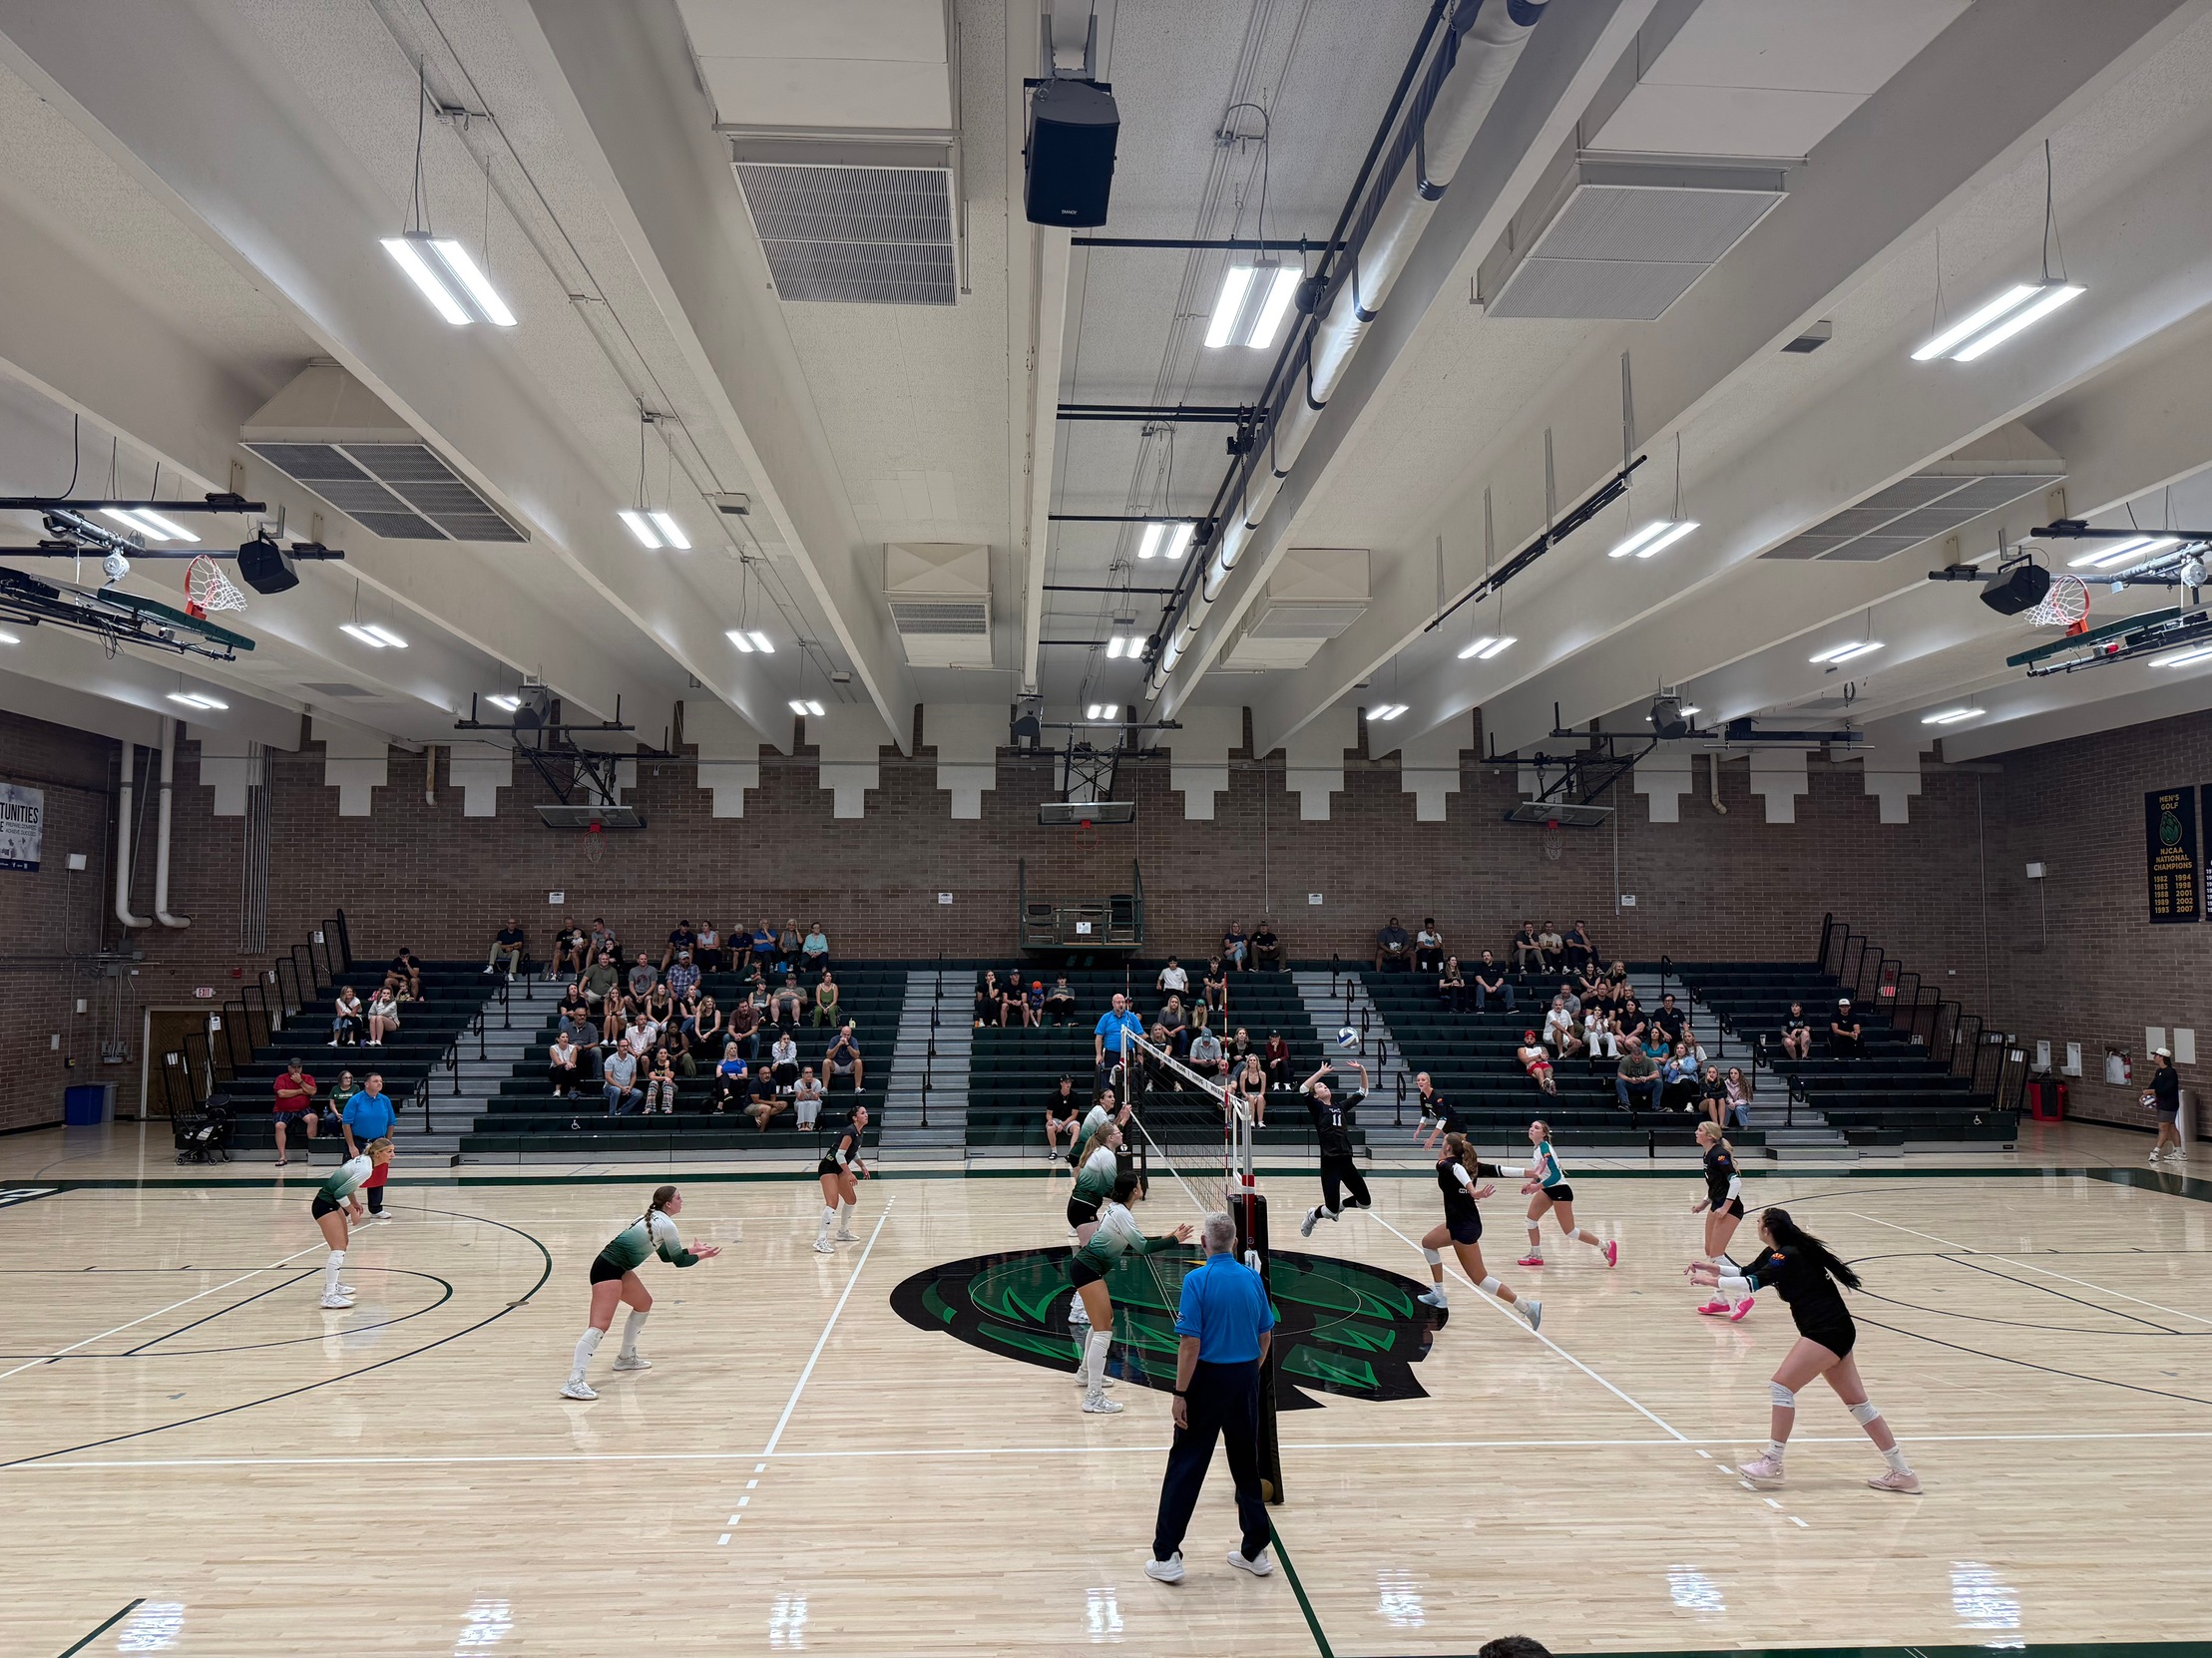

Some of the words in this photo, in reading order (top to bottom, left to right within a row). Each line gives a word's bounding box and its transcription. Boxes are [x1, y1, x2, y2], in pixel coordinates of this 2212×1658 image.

[2160, 794, 2179, 803] MEN'S
[2160, 847, 2183, 855] NJCAA
[2156, 854, 2189, 863] NATIONAL
[2153, 861, 2193, 871] CHAMPIONS
[1332, 1113, 1342, 1126] 11
